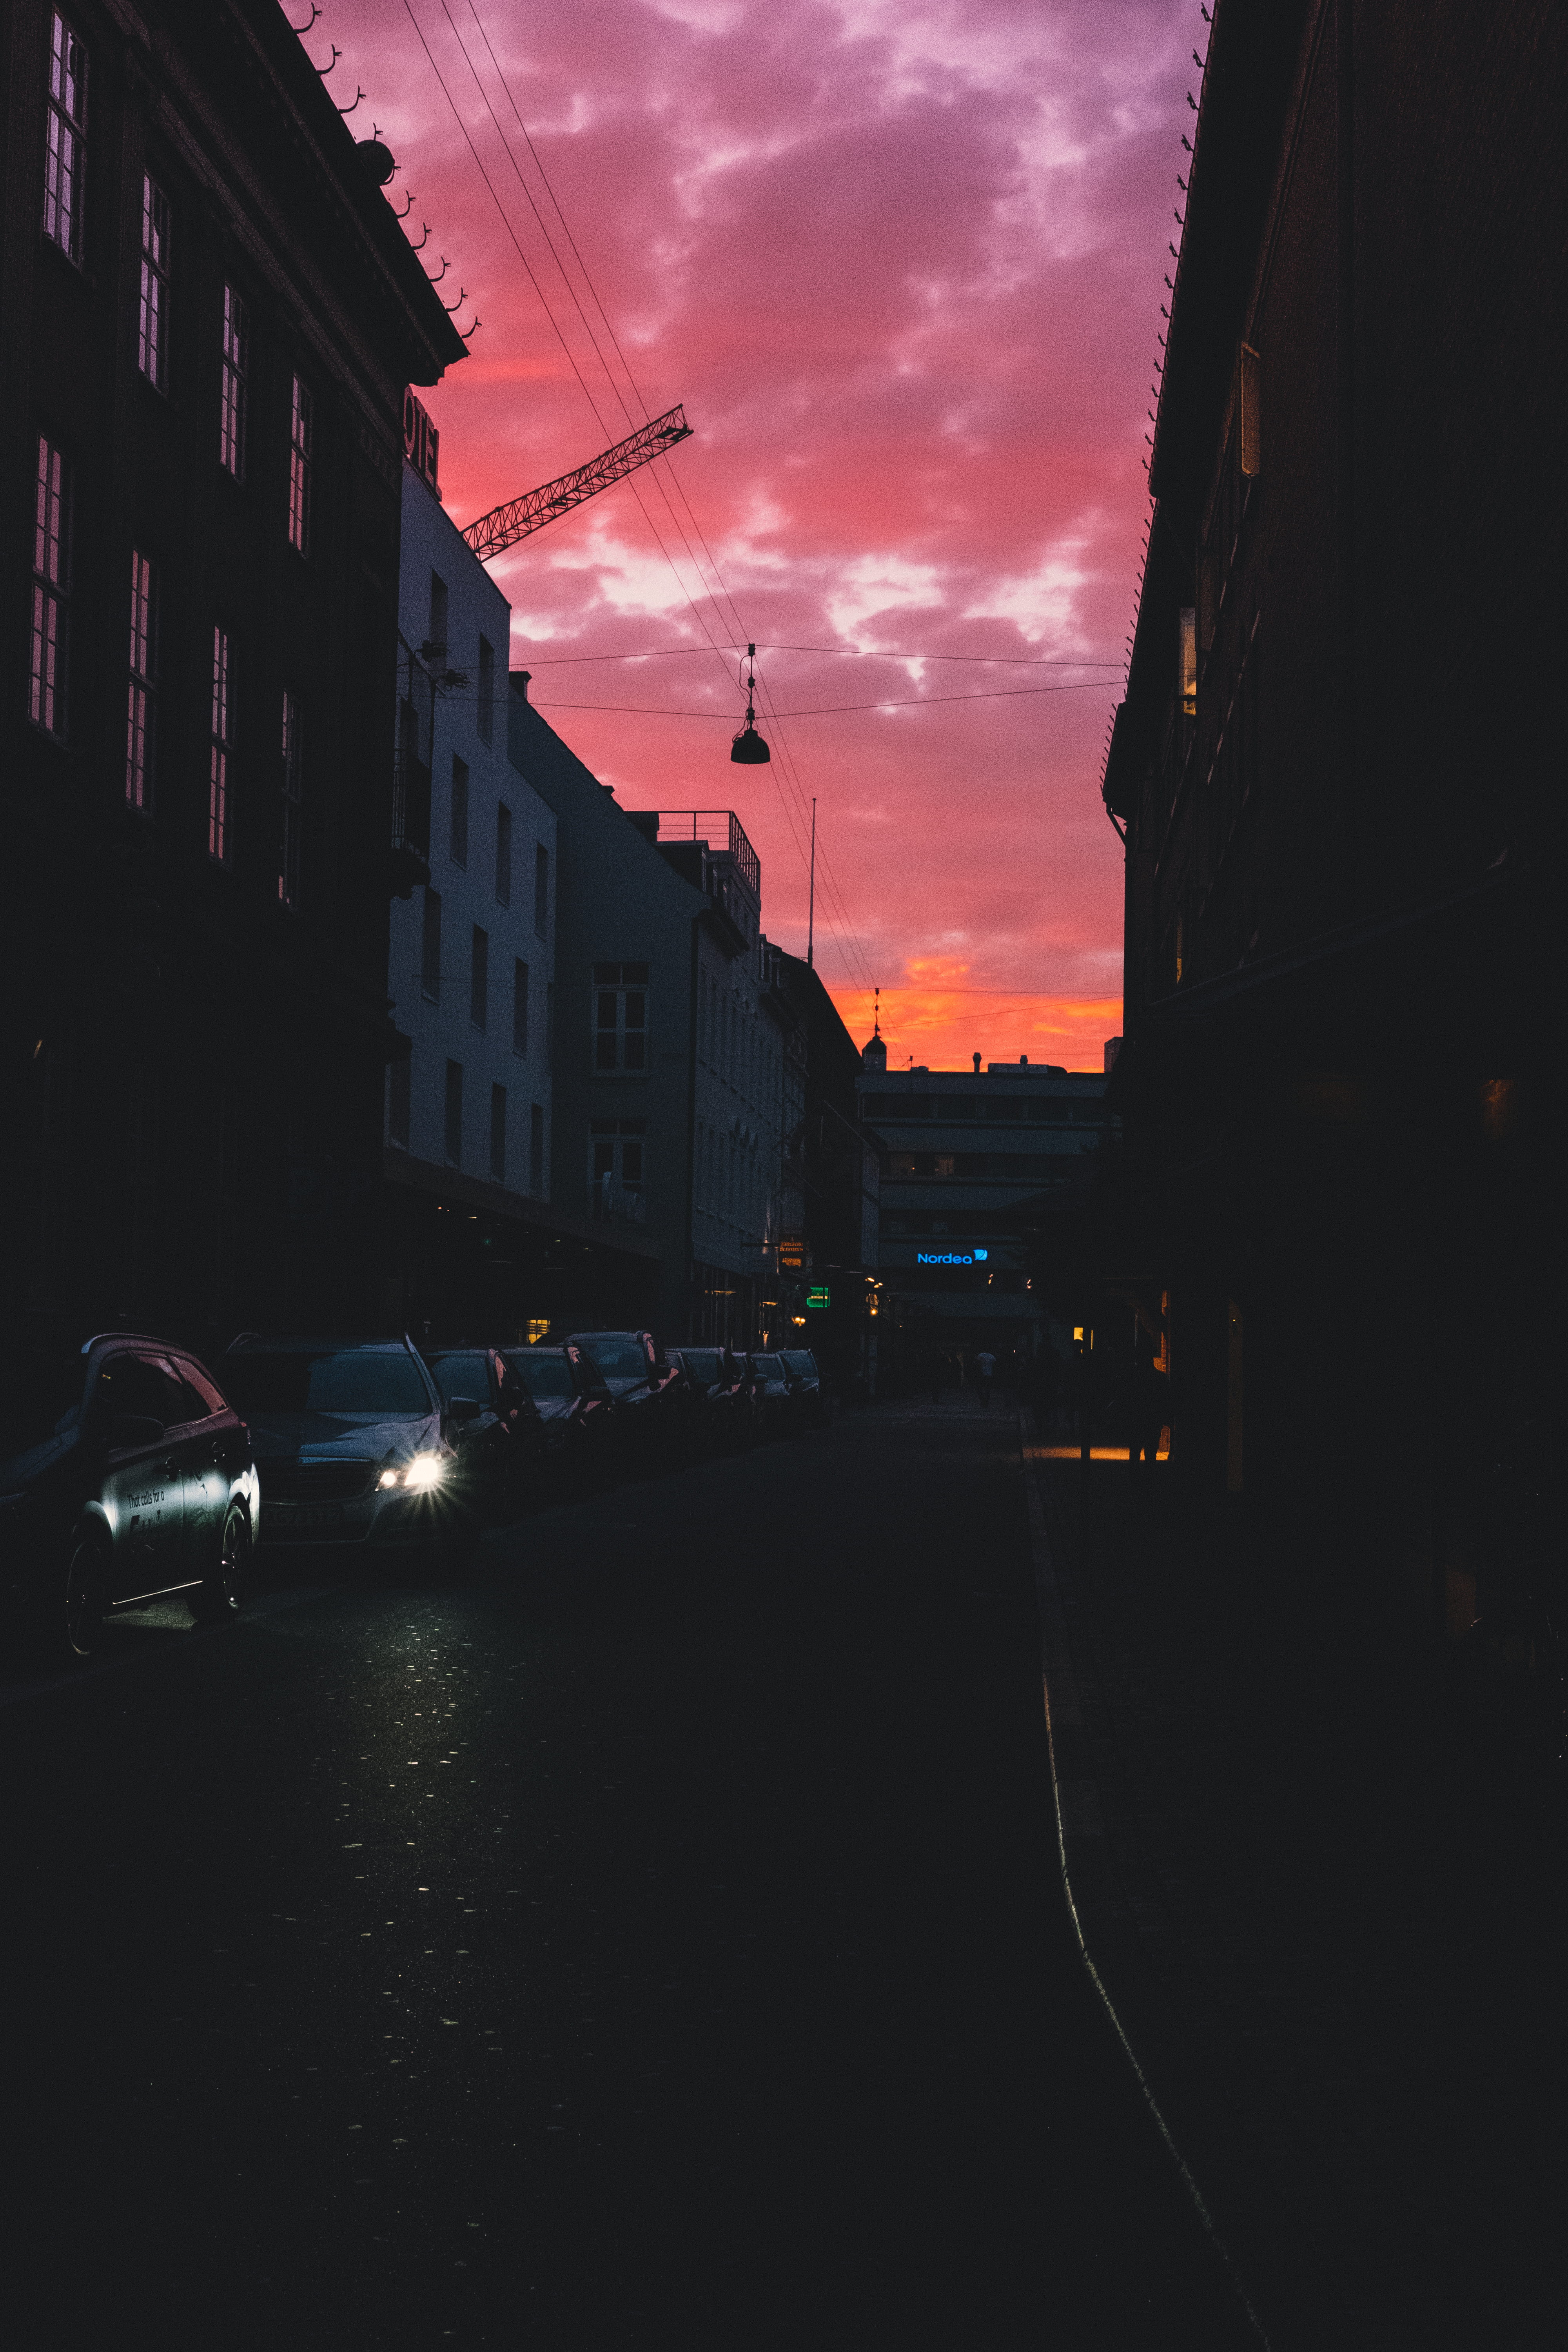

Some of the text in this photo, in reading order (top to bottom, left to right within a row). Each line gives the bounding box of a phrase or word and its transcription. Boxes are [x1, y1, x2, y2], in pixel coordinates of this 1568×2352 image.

[403, 383, 442, 502] OTEL
[917, 1252, 973, 1265] Nordea
[127, 1494, 141, 1508] That
[141, 1490, 152, 1506] calls
